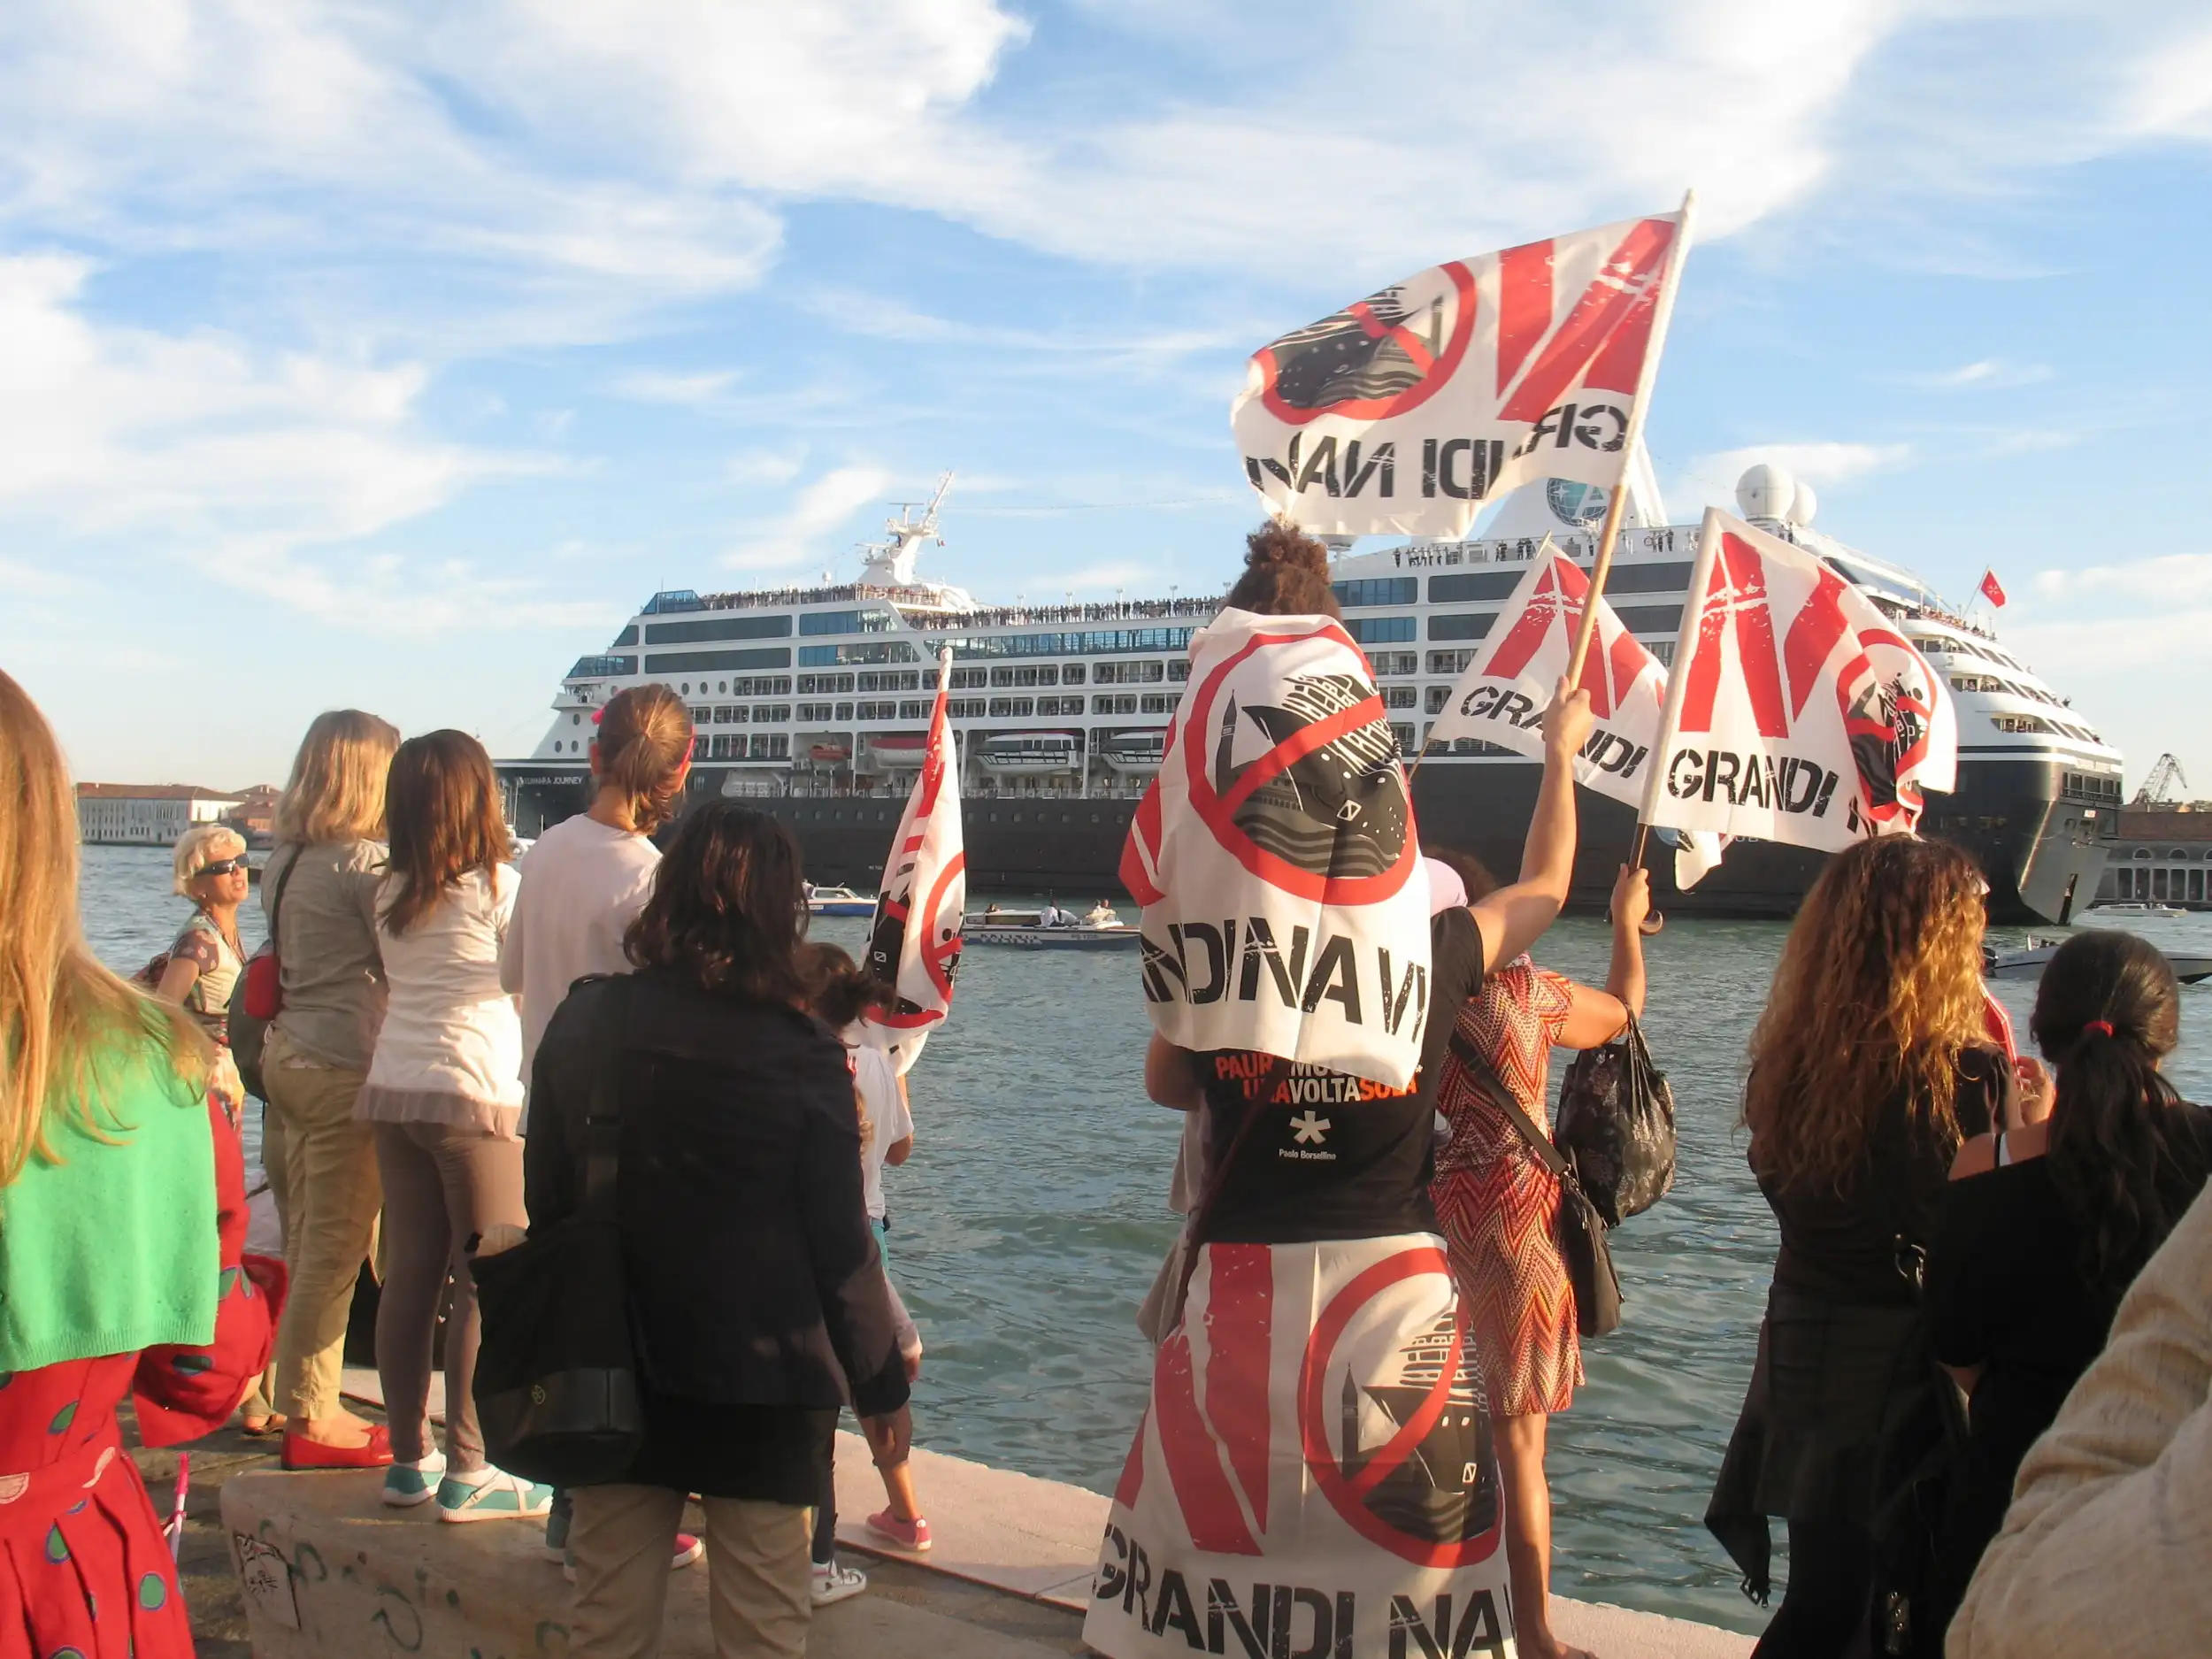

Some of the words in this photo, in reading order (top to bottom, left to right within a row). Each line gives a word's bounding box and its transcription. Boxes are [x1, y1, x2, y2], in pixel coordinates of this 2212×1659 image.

[1667, 747, 1839, 818] GRANDI
[1238, 915, 1426, 1045] NAVI
[1215, 1051, 1274, 1080] PAUR
[1279, 1148, 1299, 1159] Paolo
[1300, 1149, 1336, 1160] Borsellino
[1389, 1586, 1517, 1659] NA
